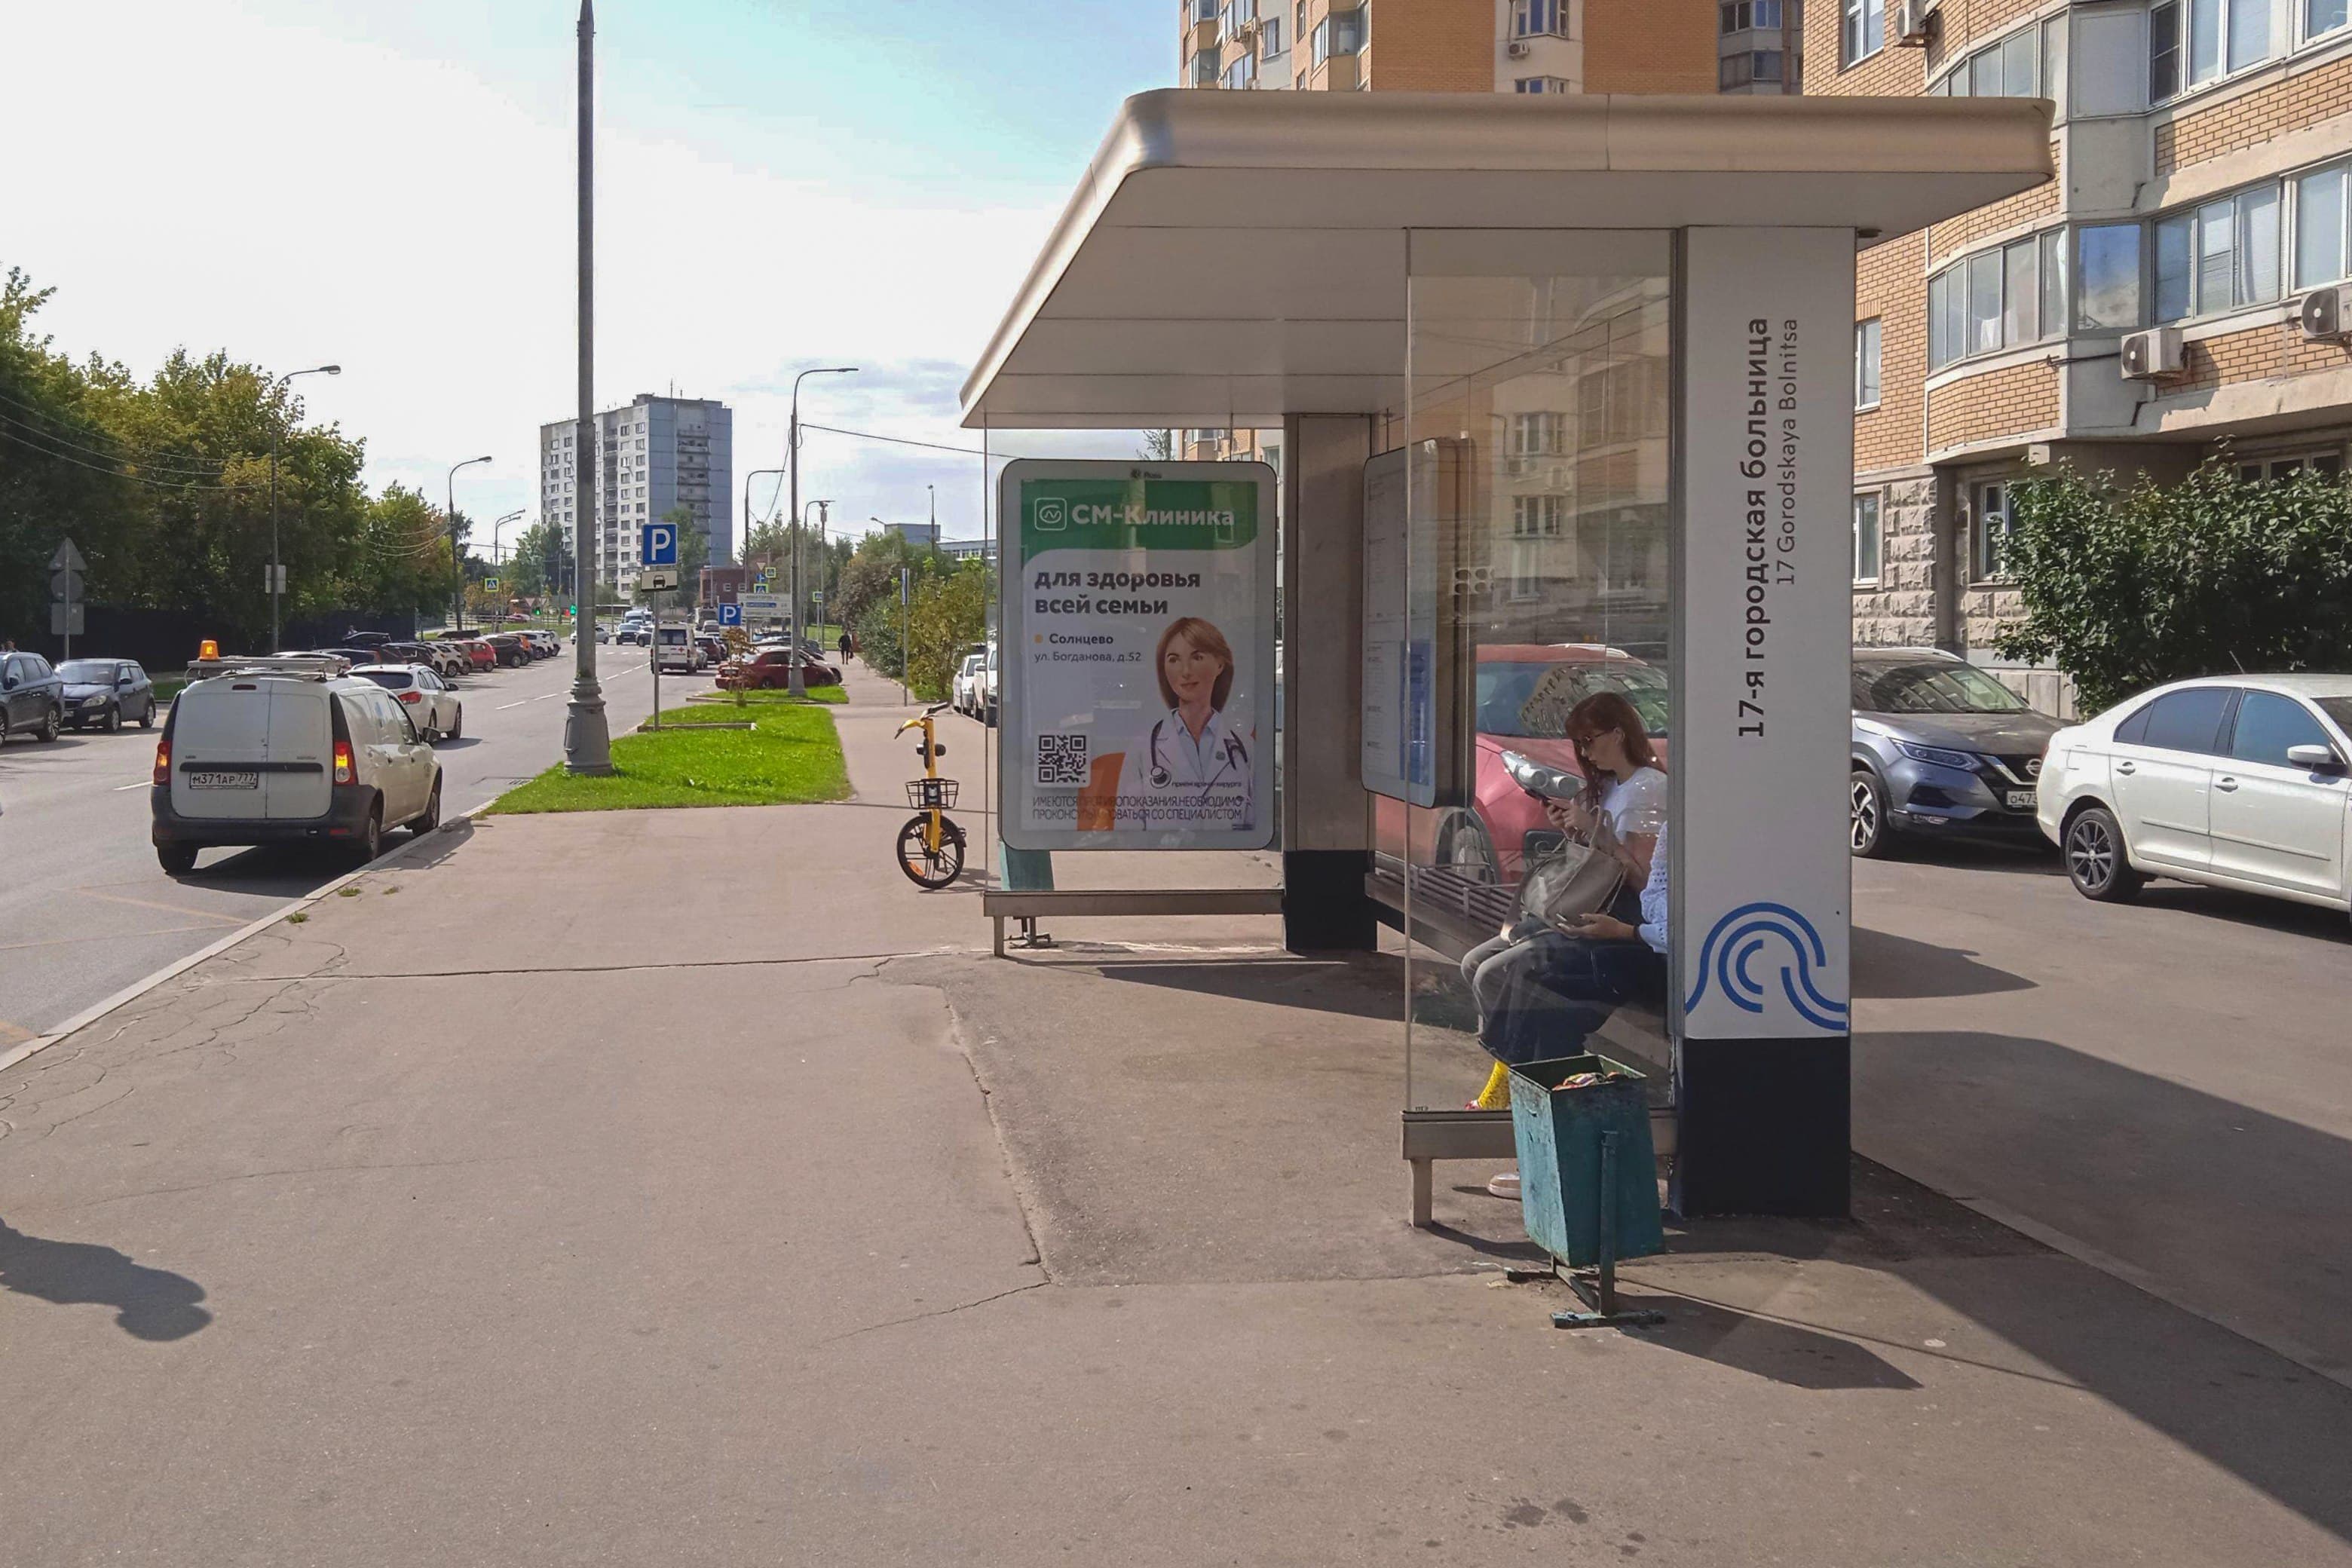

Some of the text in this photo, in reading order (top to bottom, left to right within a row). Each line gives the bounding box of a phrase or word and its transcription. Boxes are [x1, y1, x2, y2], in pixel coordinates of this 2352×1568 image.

[1776, 319, 1800, 585] 17 Gorodskaya Bolnitsa
[1072, 504, 1235, 525] СМ-Клиника
[1738, 318, 1772, 737] 17-я городская больница
[1034, 572, 1201, 592] для здоровья
[1035, 593, 1168, 614] всей семьи
[1049, 633, 1114, 645] Солнцево
[1166, 809, 1242, 820] СПЕЦИАЛИСТОМ
